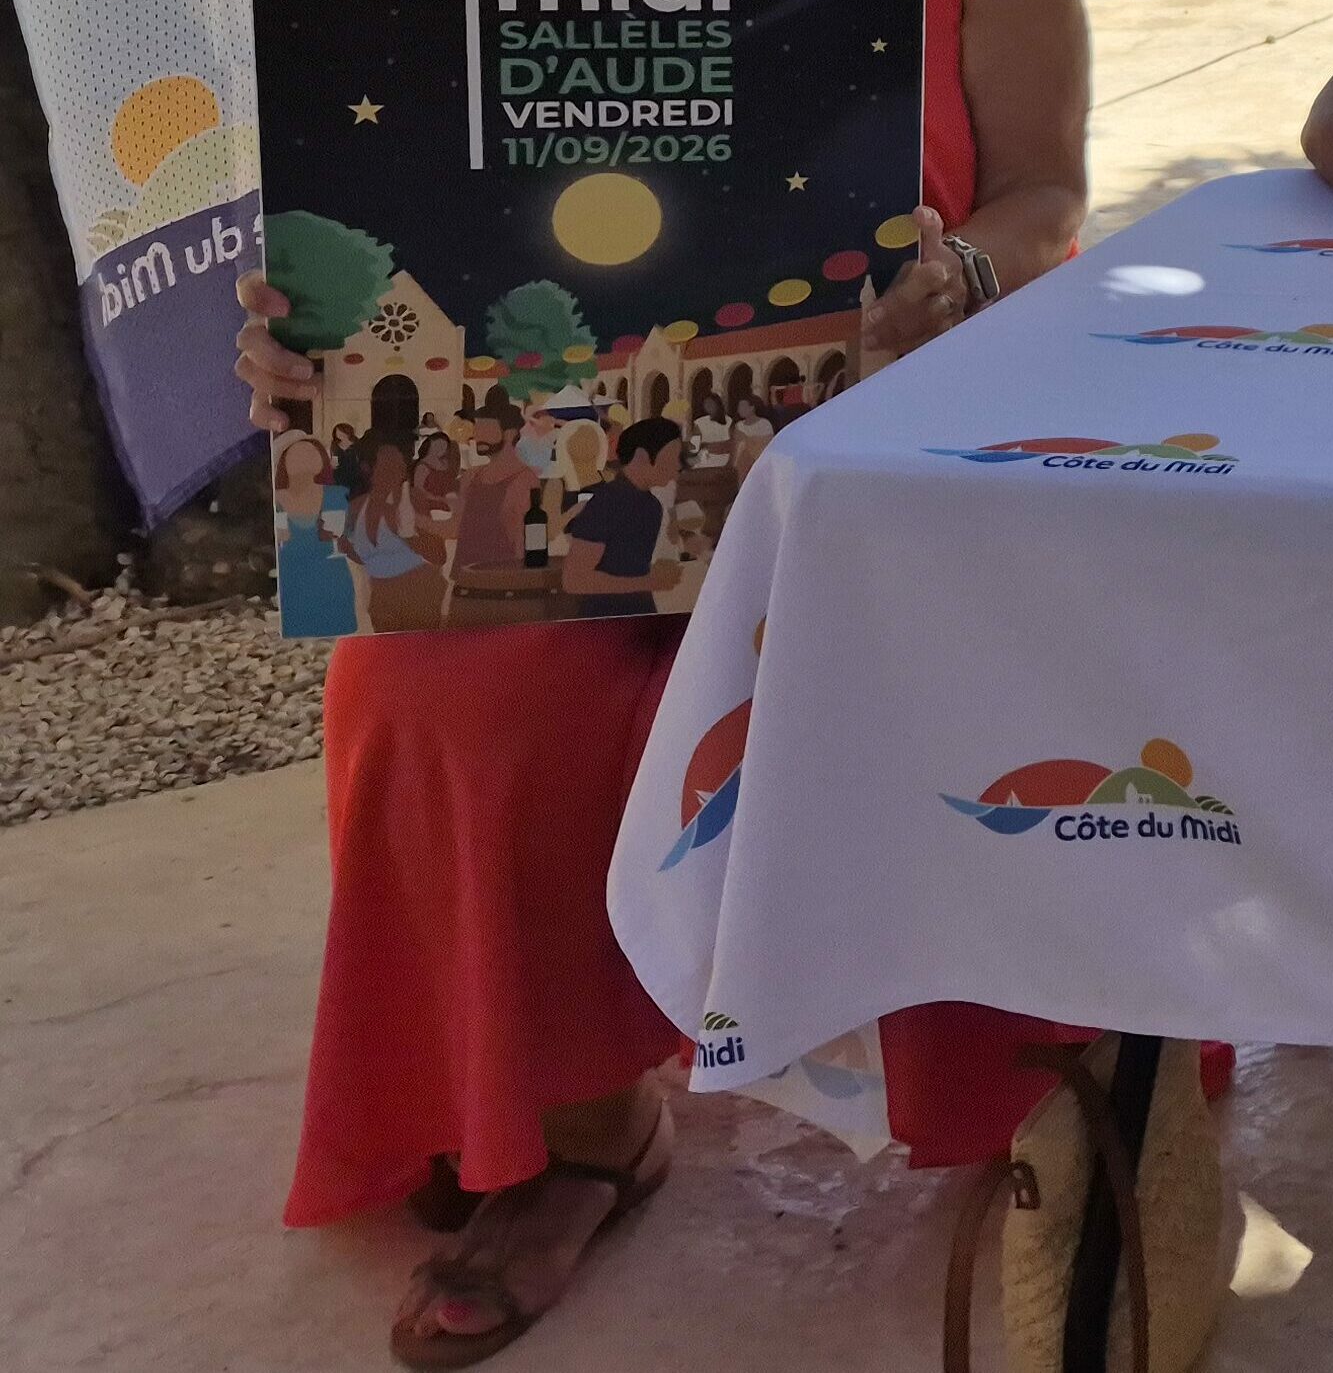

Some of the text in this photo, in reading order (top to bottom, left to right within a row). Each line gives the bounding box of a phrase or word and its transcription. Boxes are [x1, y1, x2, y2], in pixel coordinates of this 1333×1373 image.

[500, 13, 732, 50] SALLÈLES
[500, 55, 734, 96] D'AUDE
[502, 99, 734, 129] VENDREDI
[502, 131, 732, 167] 11/09/2026
[1196, 340, 1260, 351] Côte
[1264, 344, 1300, 353] du
[1043, 454, 1115, 471] Côte
[1119, 457, 1159, 473] du
[1054, 812, 1242, 845] Côte du Midi
